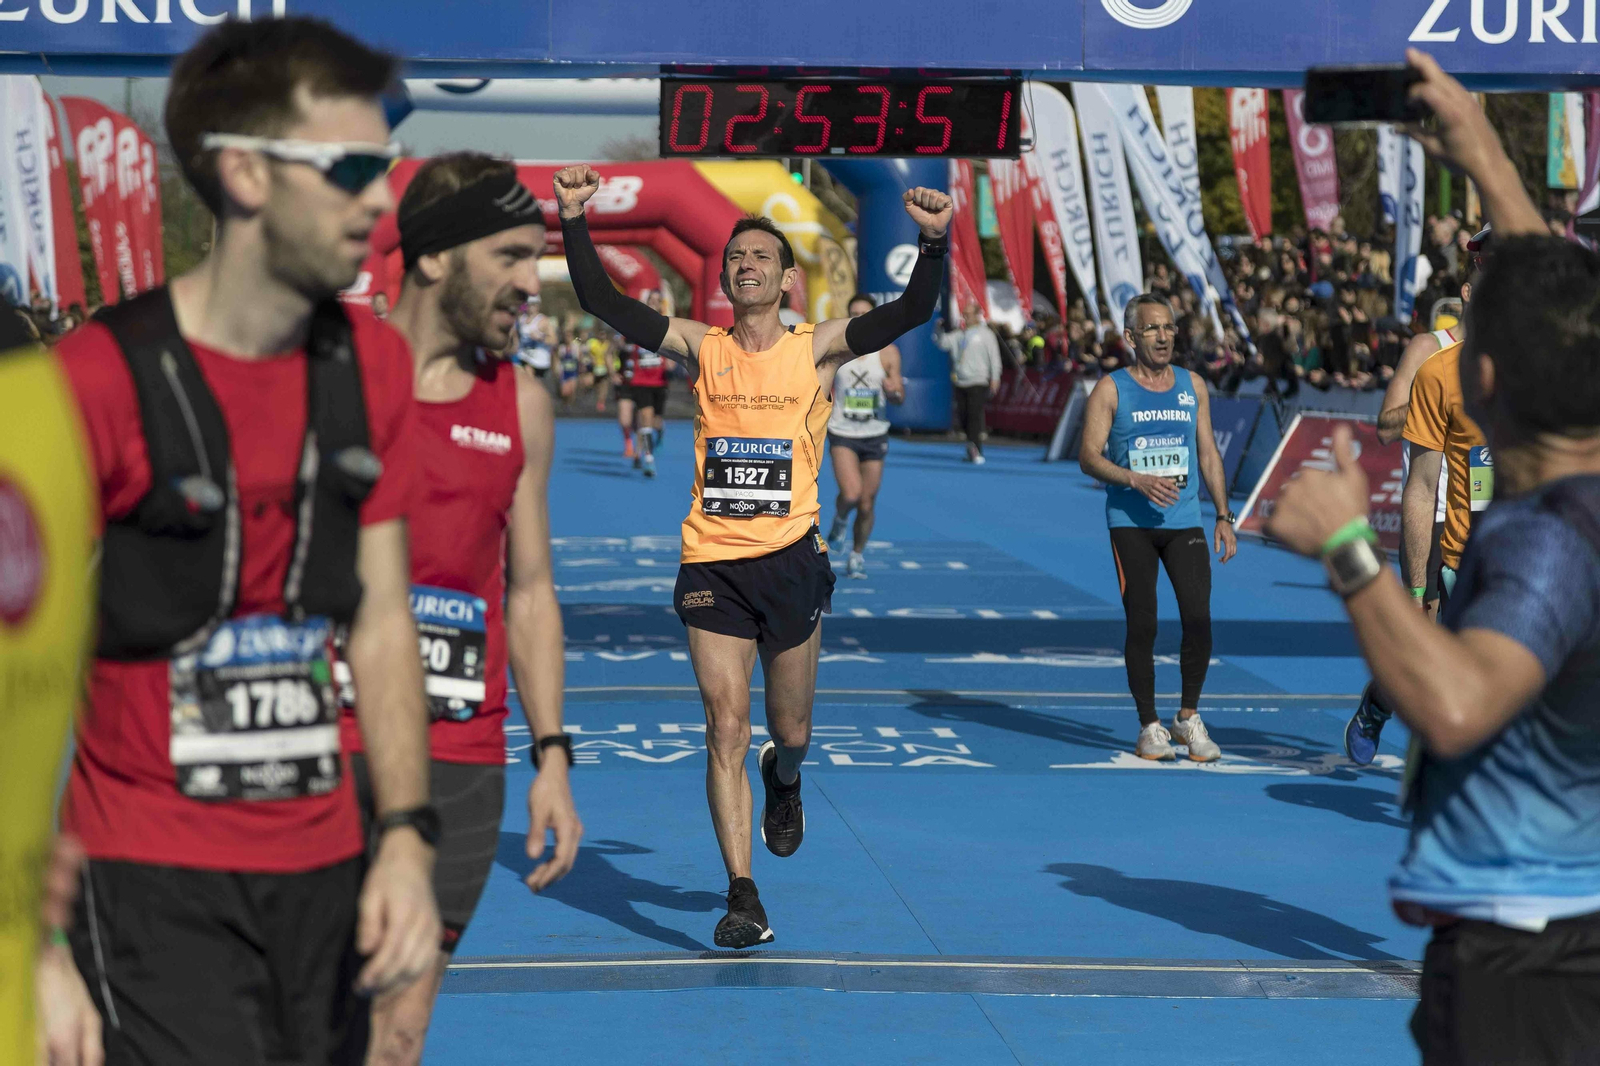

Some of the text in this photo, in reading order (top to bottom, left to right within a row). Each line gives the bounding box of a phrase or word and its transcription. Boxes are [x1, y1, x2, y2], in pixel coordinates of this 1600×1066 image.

[668, 84, 1013, 153] 02:53:51
[750, 395, 799, 404] KIROLAK
[1132, 409, 1191, 422] TROTASIERRA
[1149, 437, 1182, 447] ZURICH
[731, 443, 781, 455] ZURICH
[1142, 453, 1180, 467] 11179
[725, 466, 769, 485] 1527
[408, 593, 474, 622] URICH
